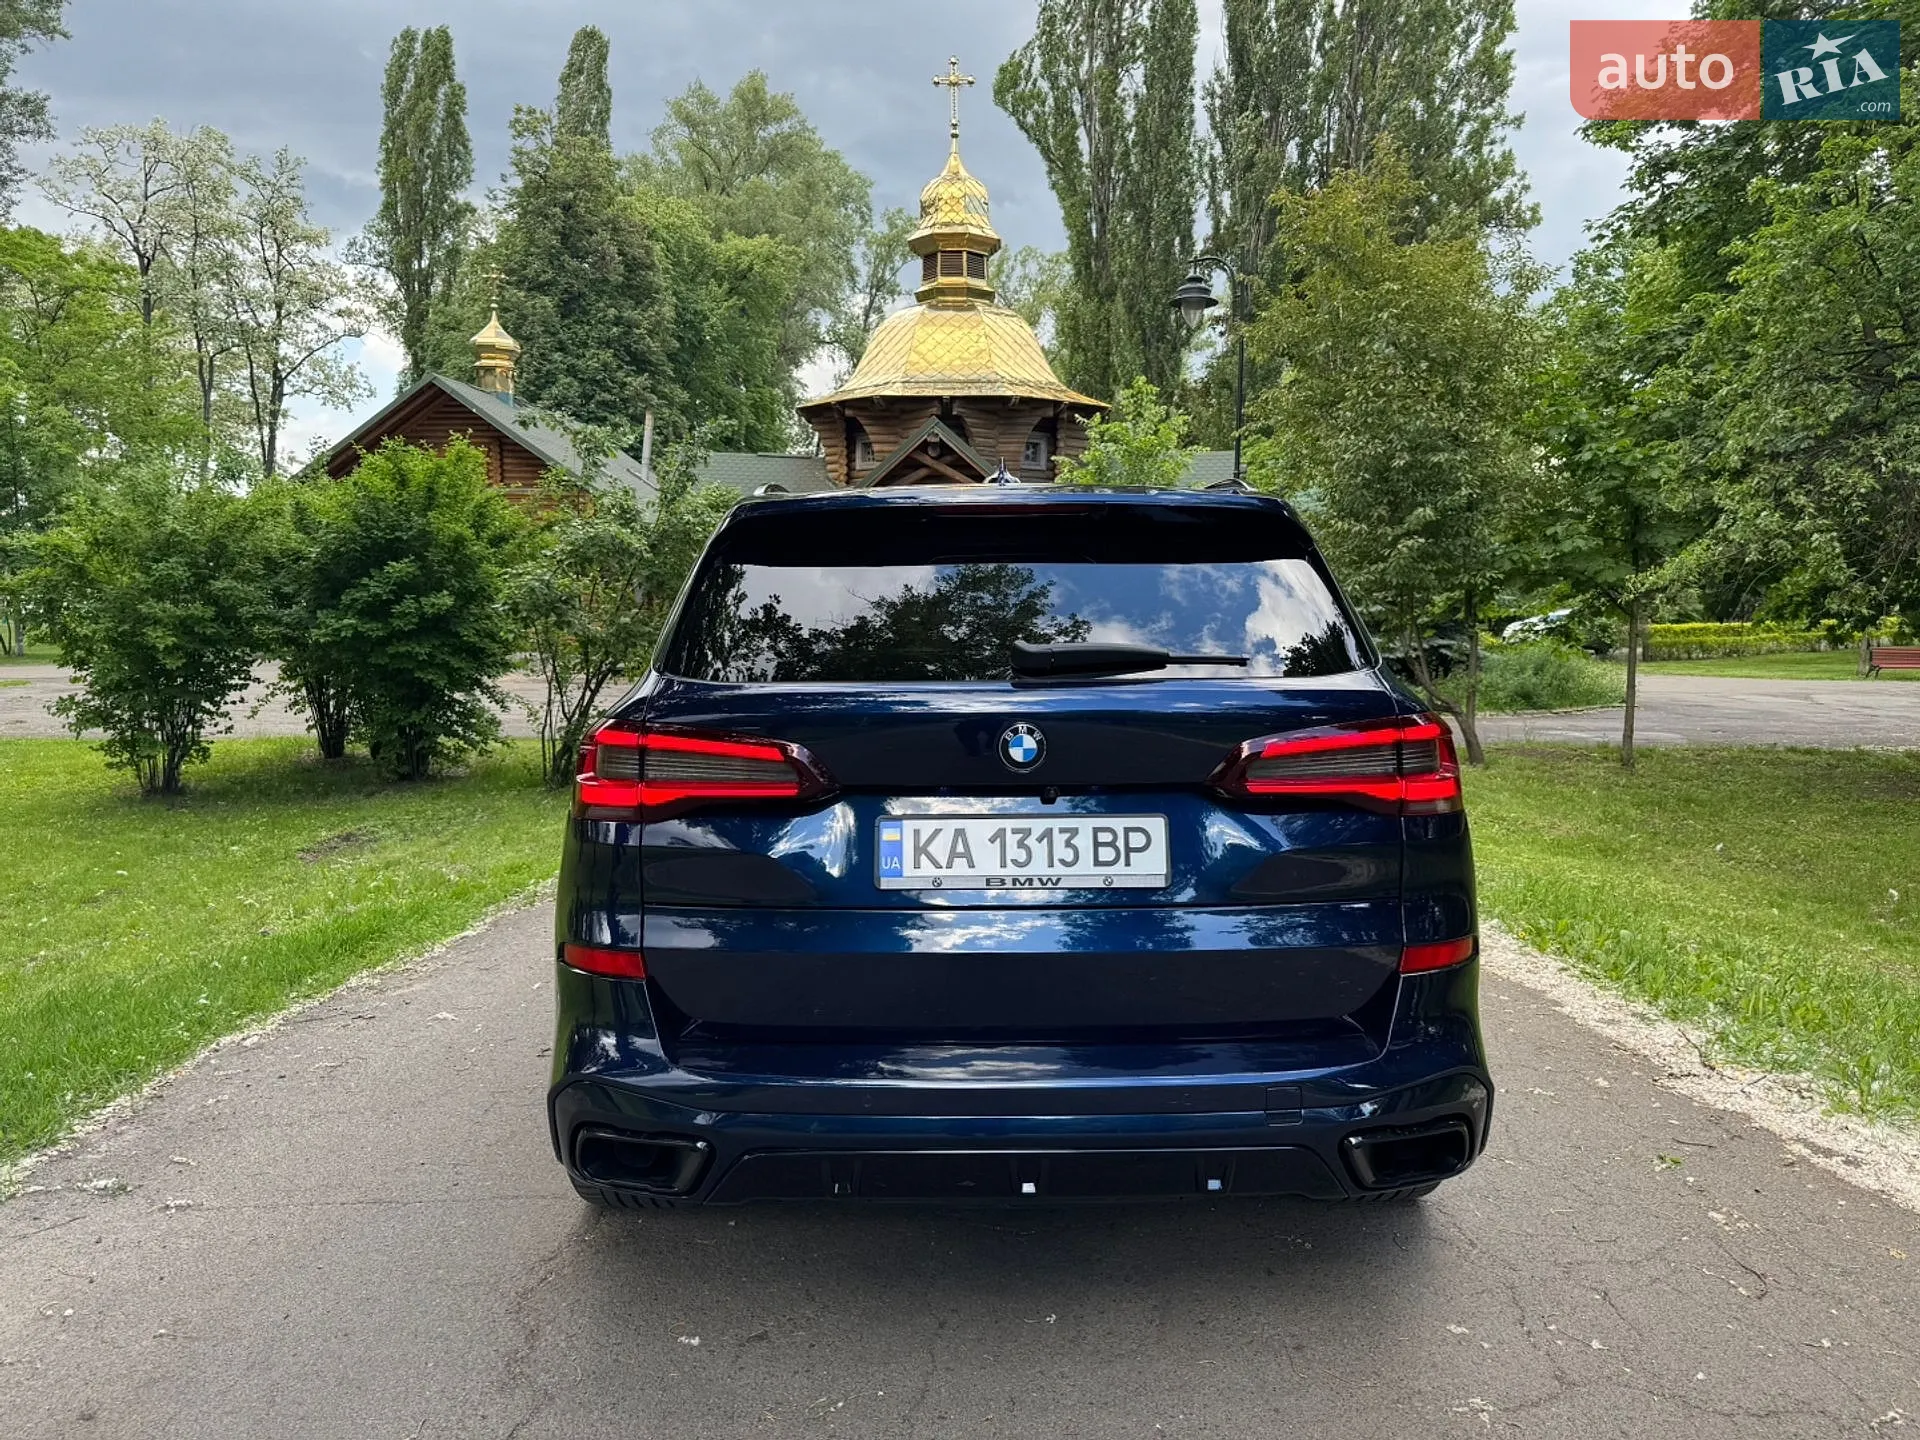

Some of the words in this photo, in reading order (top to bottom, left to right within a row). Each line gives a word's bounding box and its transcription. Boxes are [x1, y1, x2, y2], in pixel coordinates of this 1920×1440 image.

[913, 828, 976, 870] KA
[988, 827, 1080, 868] 1313
[1092, 826, 1152, 867] BP
[881, 858, 901, 870] UA
[985, 877, 1062, 887] BMW
